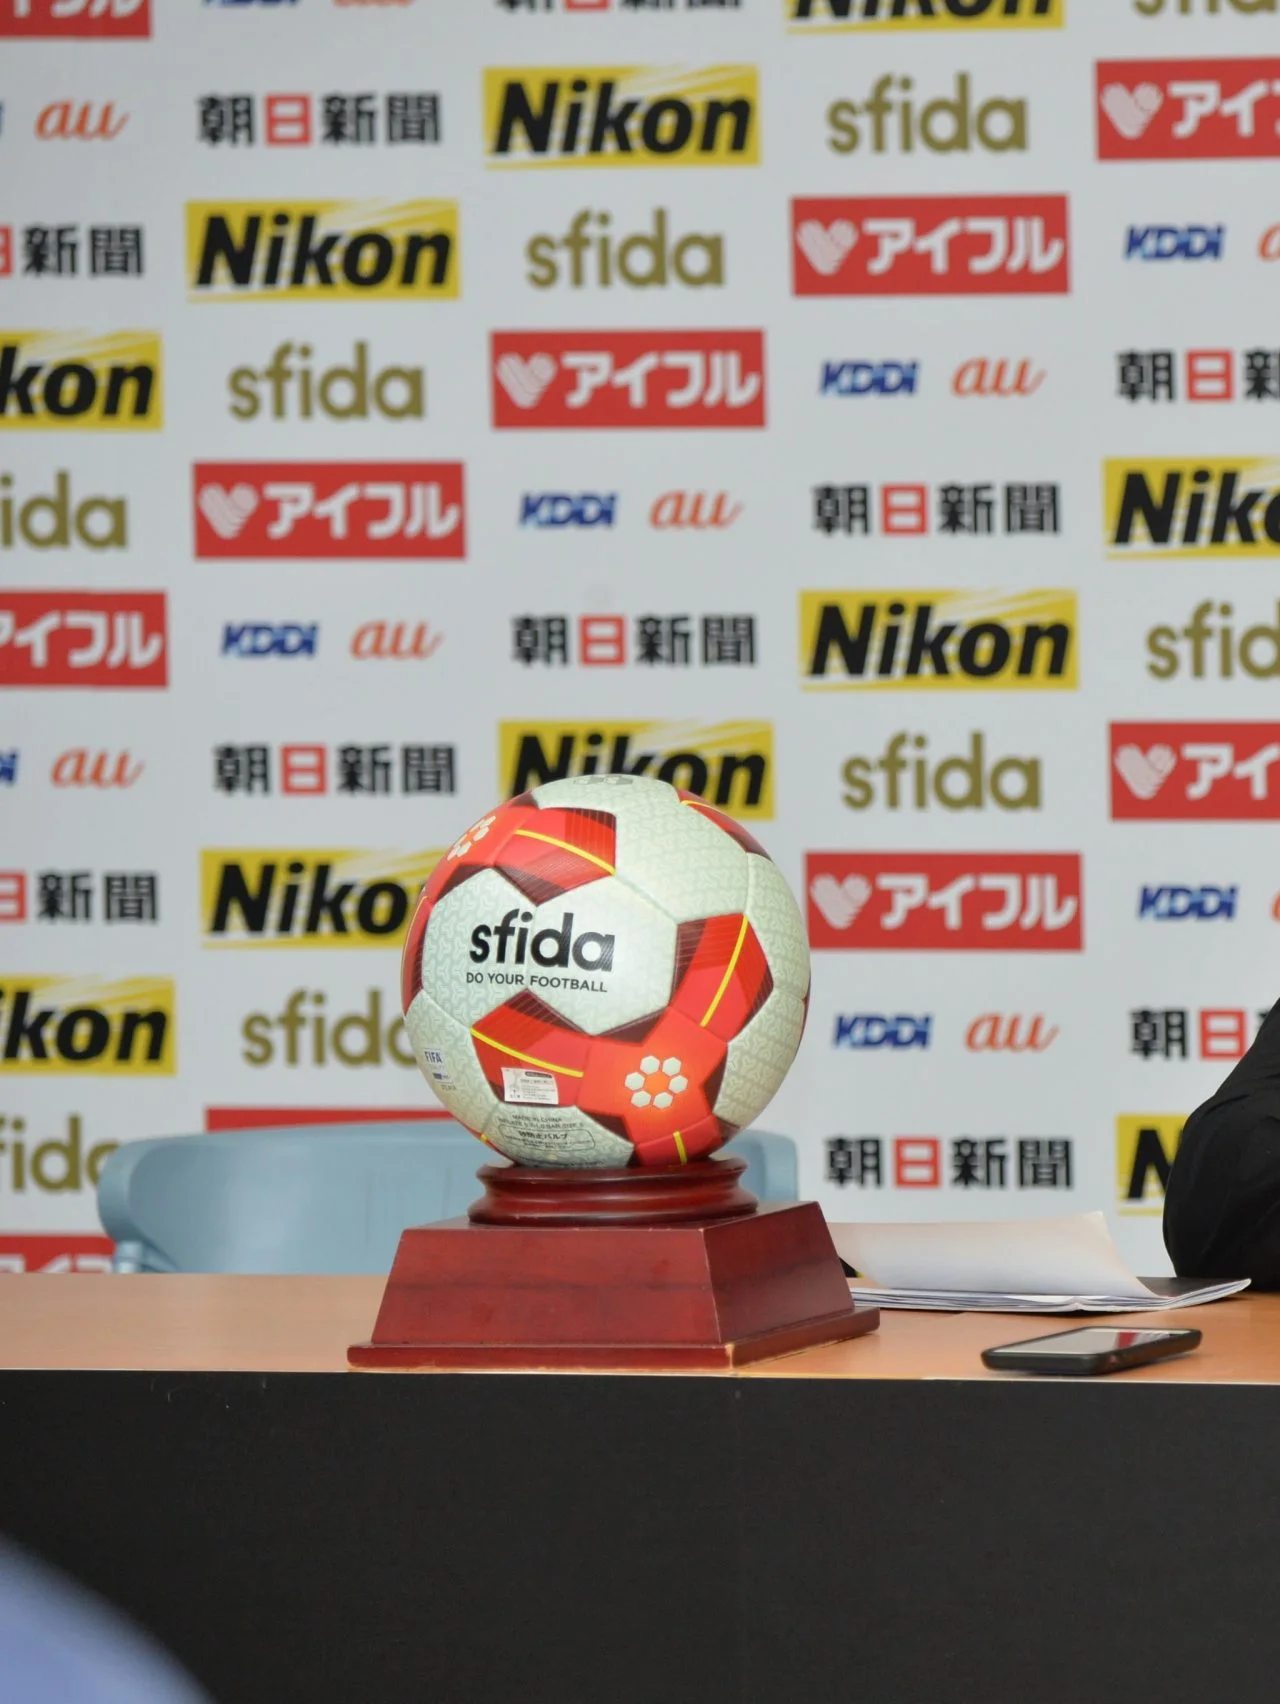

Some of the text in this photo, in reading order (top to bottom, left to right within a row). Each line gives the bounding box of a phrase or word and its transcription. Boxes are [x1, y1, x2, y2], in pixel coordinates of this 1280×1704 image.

[35, 101, 125, 138] au
[199, 93, 440, 145] 朝日新聞
[494, 79, 751, 154] Nikon
[828, 75, 1026, 153] sfida
[0, 224, 145, 277] 新聞
[196, 213, 451, 287] Nikon
[528, 210, 723, 287] sfida
[864, 217, 1064, 274] アイフル
[1125, 225, 1224, 261] KDDI
[0, 344, 156, 418] kon
[229, 343, 423, 419] sfida
[562, 352, 760, 407] アイフル
[821, 358, 1043, 397] KDDI au
[0, 470, 128, 549] ida
[264, 483, 459, 538] アイフル
[521, 491, 739, 528] KDDI au
[815, 483, 1059, 536] 朝日新聞
[0, 608, 163, 670] イフル
[223, 622, 439, 658] KDDI au
[514, 615, 755, 666] 朝日新聞
[810, 602, 1070, 678] Nikon
[51, 750, 142, 786] au
[216, 745, 455, 795] 朝日新聞
[843, 732, 1040, 810] sfida
[210, 860, 424, 937] Niko
[881, 874, 1077, 929] アイフル
[1139, 885, 1238, 921] KDDI
[469, 908, 616, 973] sfida
[466, 972, 608, 993] DO YOUR FOOTBALL
[0, 989, 167, 1063] kon
[834, 1013, 1056, 1051] KDDI au
[1130, 1009, 1268, 1061] 朝日
[827, 1137, 1072, 1189] 朝日新聞
